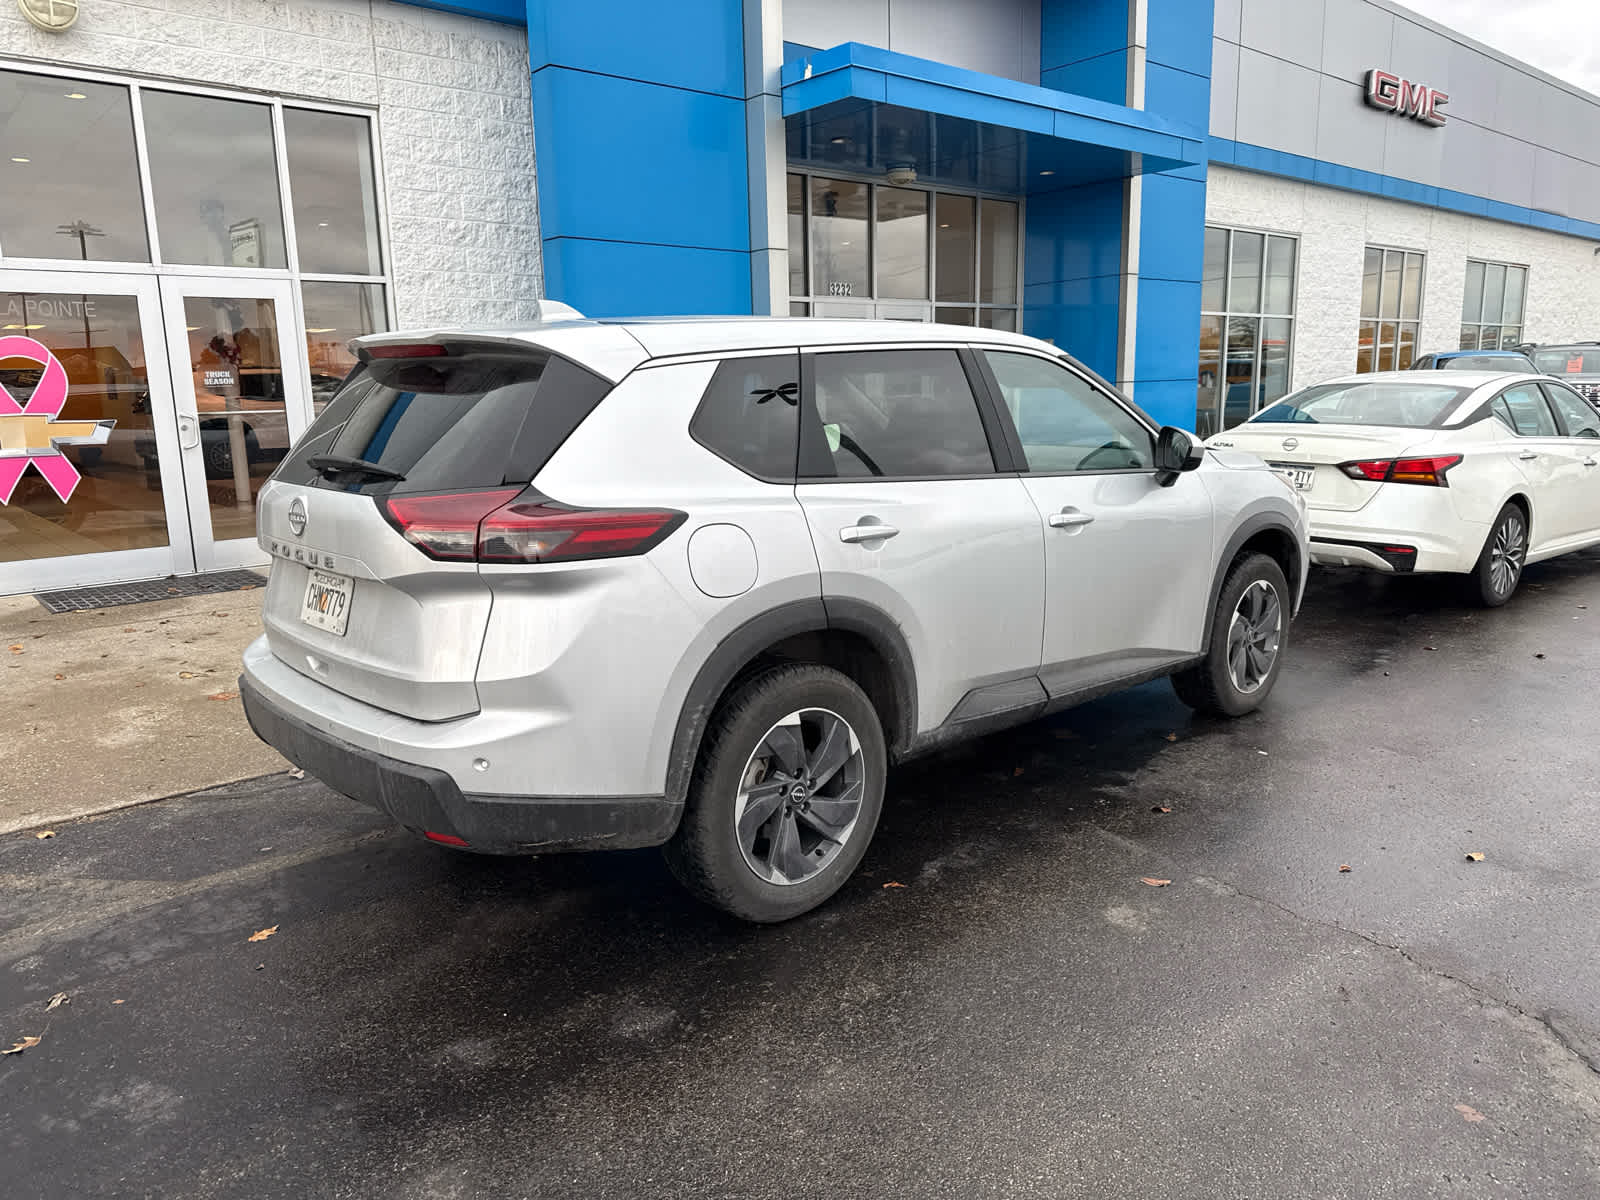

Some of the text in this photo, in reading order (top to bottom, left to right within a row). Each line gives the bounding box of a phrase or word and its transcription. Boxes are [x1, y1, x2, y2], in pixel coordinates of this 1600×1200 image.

[1364, 69, 1449, 127] GMC
[830, 282, 851, 297] 3232
[25, 299, 96, 318] POINTE
[203, 377, 235, 385] SEASON
[204, 370, 231, 378] TRUCK
[272, 541, 334, 569] ROGUE
